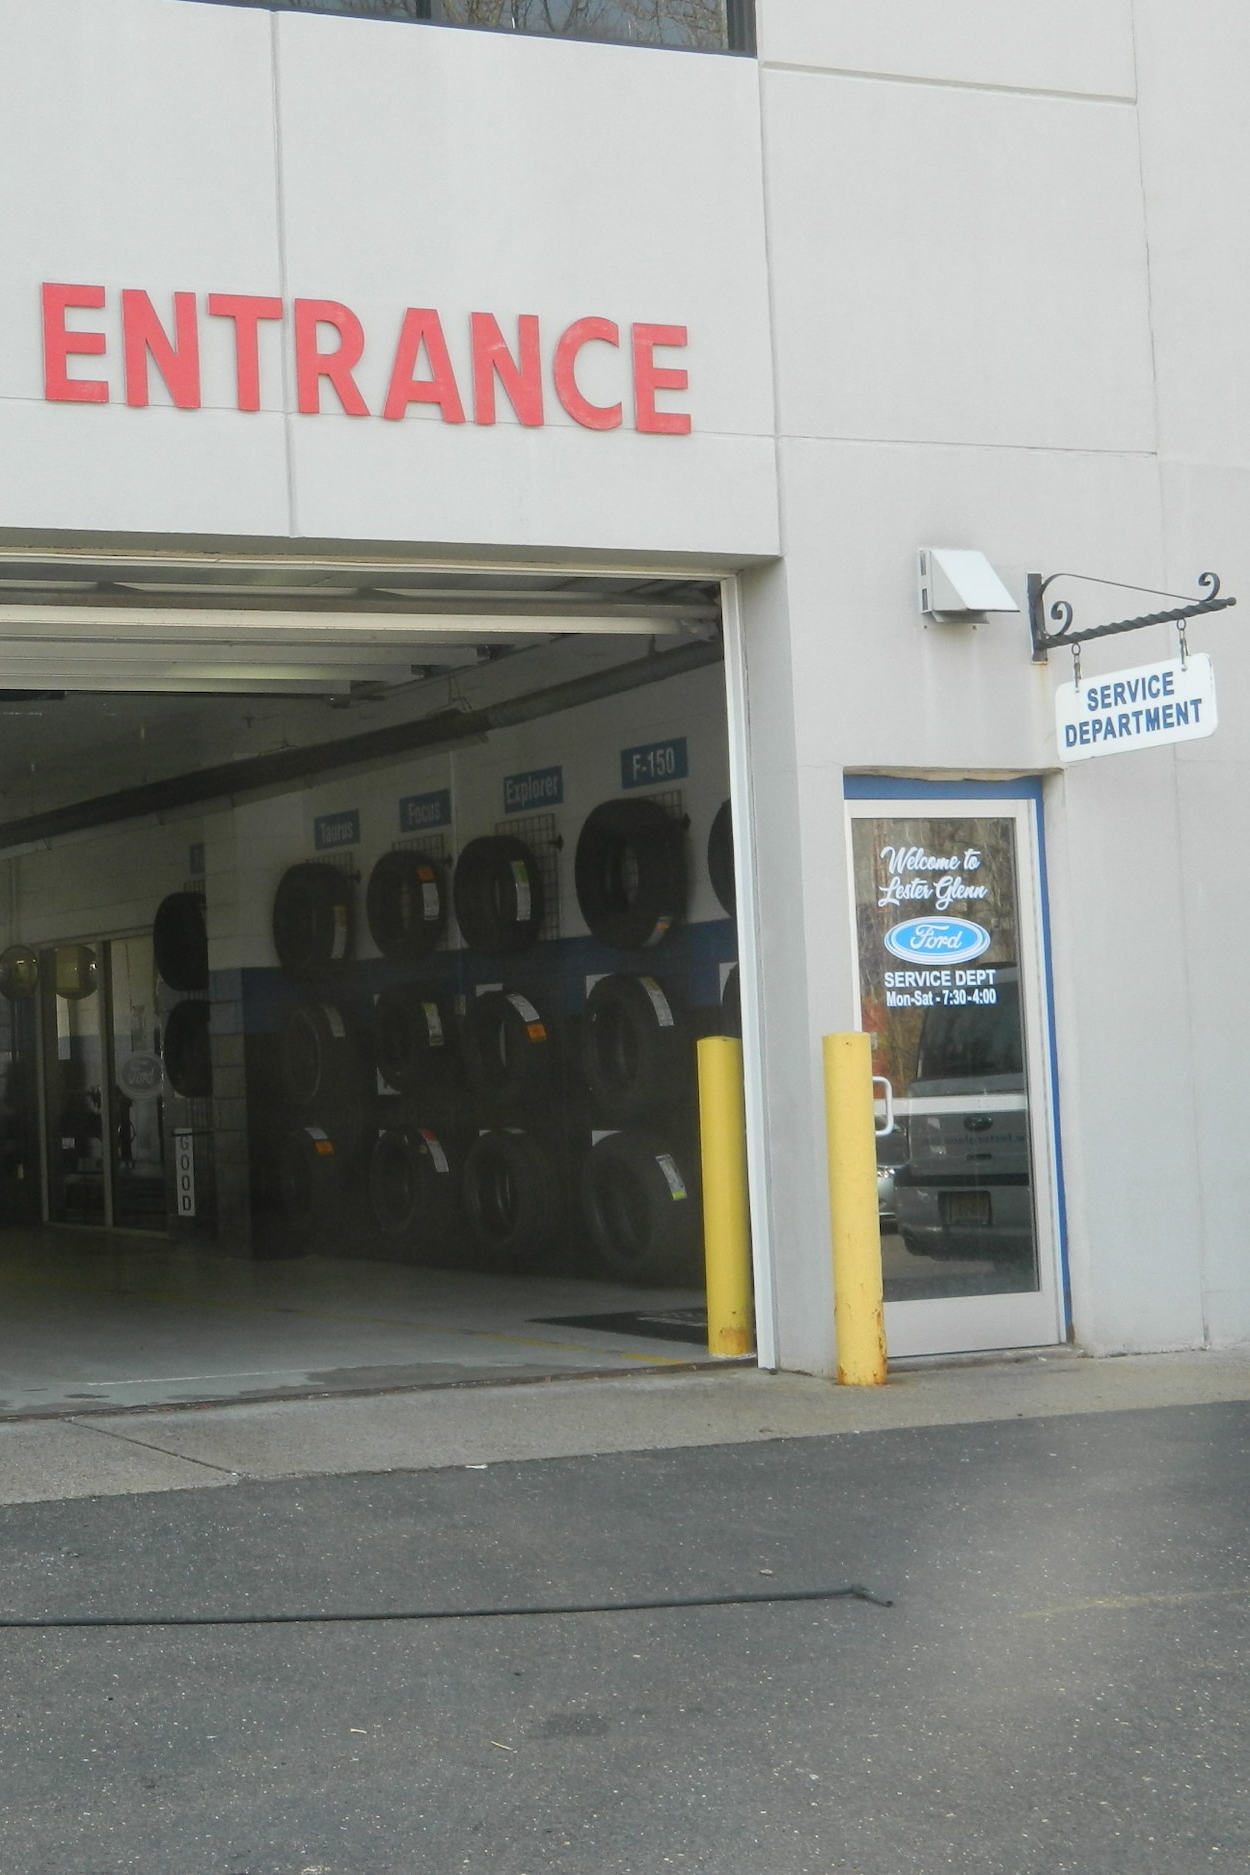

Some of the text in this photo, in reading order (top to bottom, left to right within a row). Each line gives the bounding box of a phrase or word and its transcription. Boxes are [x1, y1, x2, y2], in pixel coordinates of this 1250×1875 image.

[41, 282, 692, 435] ENTRANCE
[1086, 671, 1175, 712] SERVICE
[1064, 698, 1203, 748] DEPARTMENT
[632, 747, 676, 781] F-150
[505, 774, 559, 808] Explorer
[407, 801, 442, 825] Focus
[318, 821, 354, 844] Taurus
[880, 846, 982, 874] Welcome to
[877, 875, 989, 911] Lester Glenn
[909, 924, 964, 950] Ford
[884, 969, 997, 988] SERVICE DEPT
[886, 989, 934, 1007] Mon-Sat
[180, 1135, 192, 1211] GOOD
